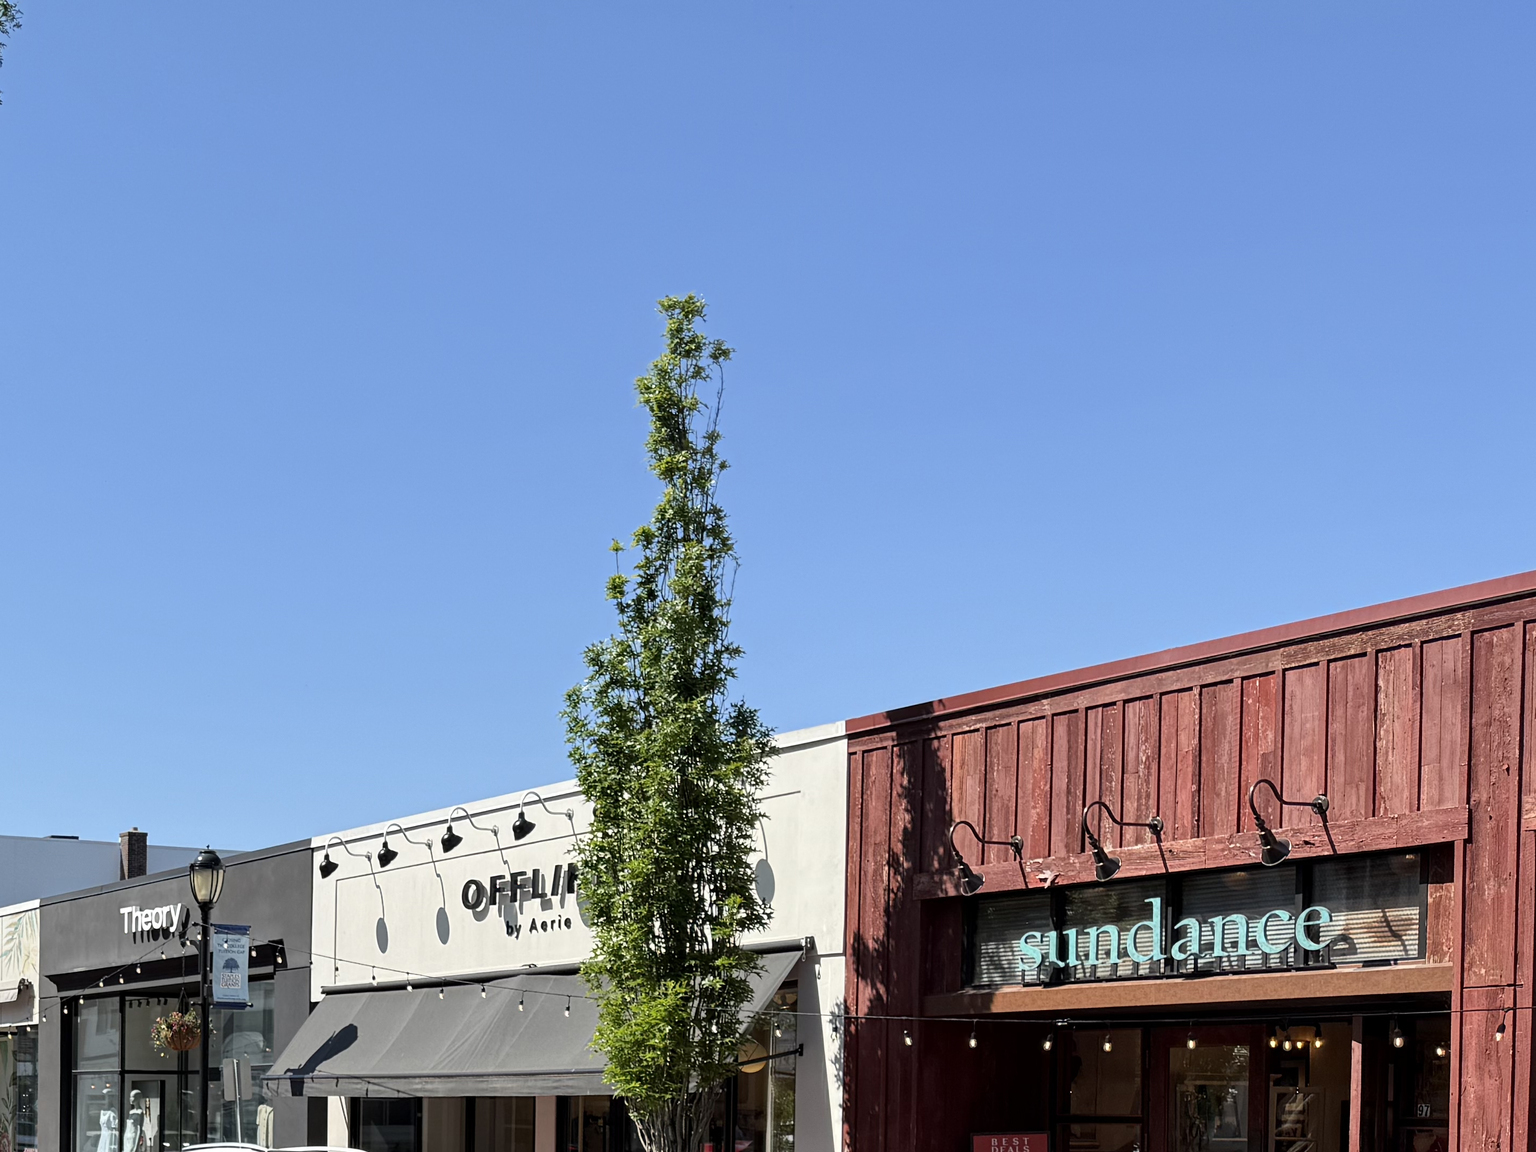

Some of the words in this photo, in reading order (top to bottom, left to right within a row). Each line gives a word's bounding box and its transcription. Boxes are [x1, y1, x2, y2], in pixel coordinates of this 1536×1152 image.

[120, 903, 182, 934] Theory
[506, 921, 522, 940] by
[529, 915, 572, 935] Aerie
[1018, 897, 1333, 971] sundance
[1418, 1105, 1430, 1117] 97
[991, 1137, 1029, 1146] BEST
